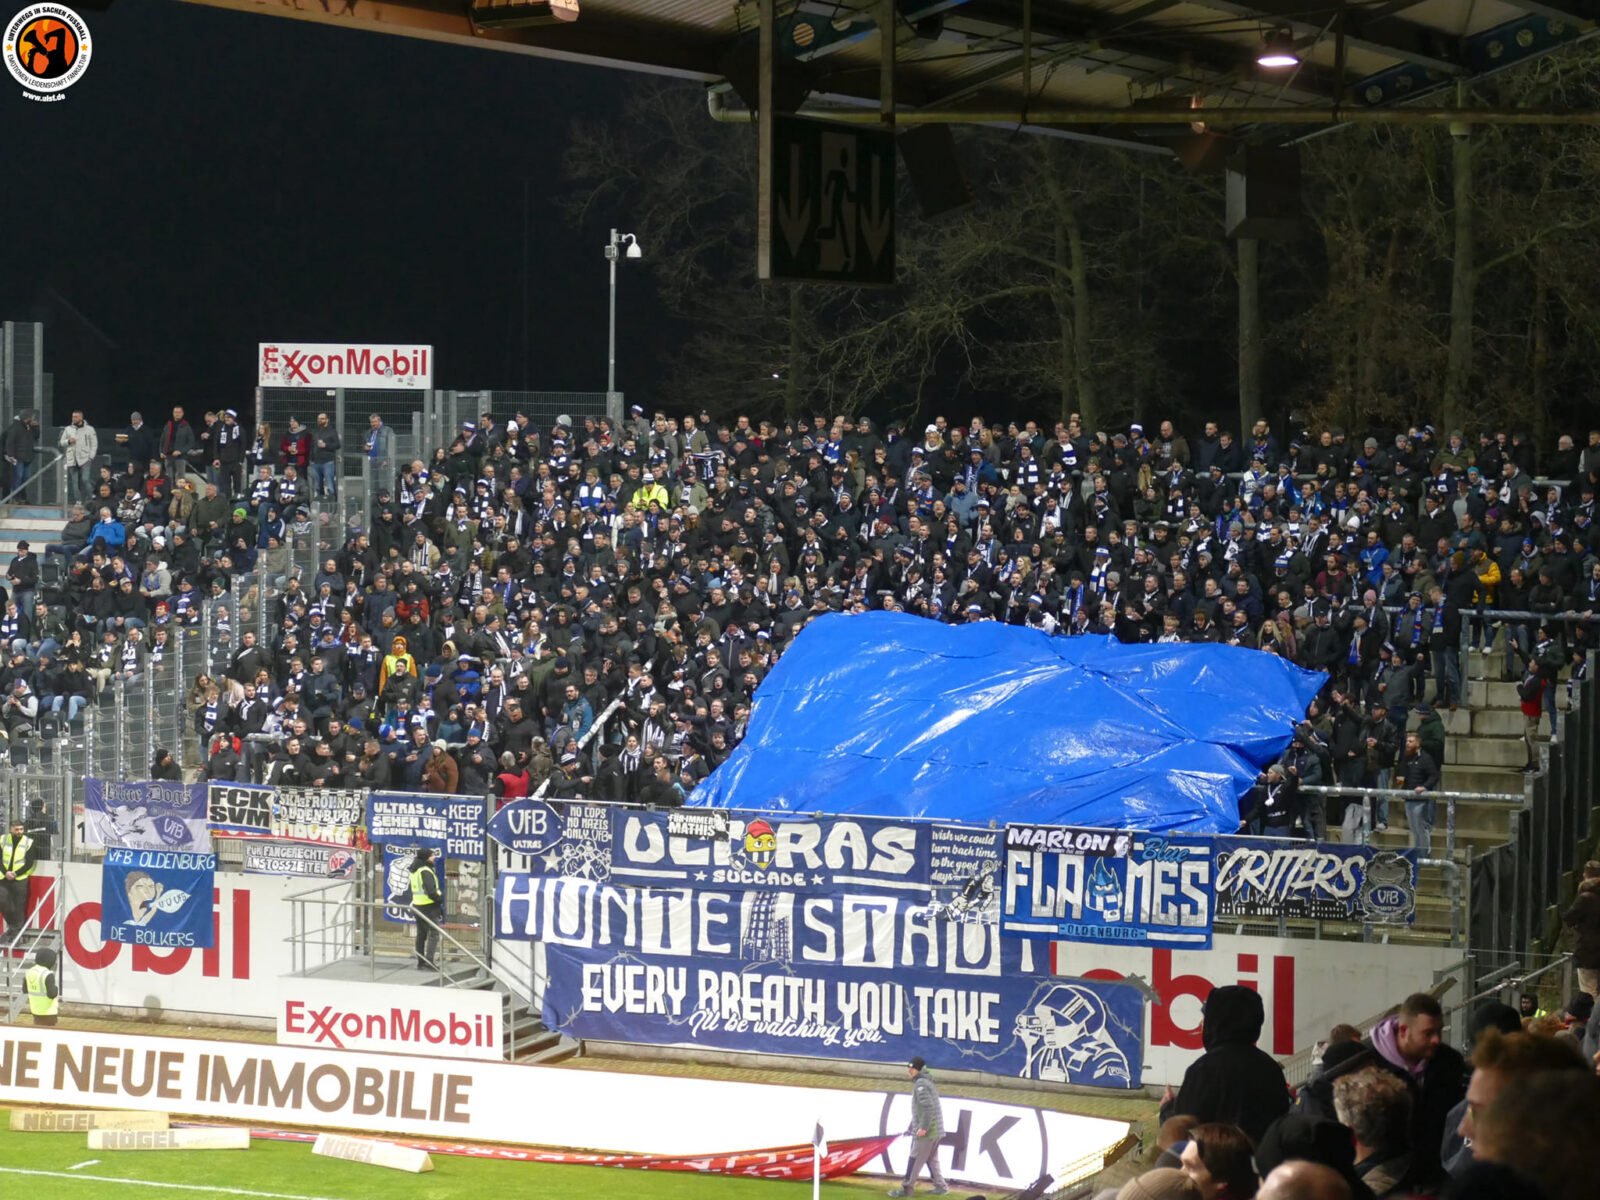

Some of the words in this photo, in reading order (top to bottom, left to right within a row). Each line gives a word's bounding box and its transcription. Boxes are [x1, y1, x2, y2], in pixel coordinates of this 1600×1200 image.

[263, 347, 427, 384] ExxonMobil
[146, 784, 193, 807] Dogs
[210, 787, 272, 810] FCK
[210, 805, 270, 828] SVM
[373, 802, 425, 815] ULTRAS
[448, 804, 482, 820] KEEP
[570, 806, 582, 817] NO
[584, 806, 607, 819] COPS
[372, 815, 420, 828] SEHEN
[423, 817, 447, 832] UN
[507, 809, 547, 835] VfB
[567, 816, 579, 828] NO
[581, 817, 608, 830] NAZIS
[668, 812, 684, 823] FÜR
[686, 814, 714, 825] IMMER
[163, 818, 185, 840] VfB
[372, 827, 413, 837] GESEHEN
[453, 821, 479, 837] THE
[566, 828, 589, 840] ONLY
[591, 830, 609, 842] VfB
[668, 821, 715, 837] MATHIS
[932, 829, 953, 842] wish
[954, 833, 968, 843] we
[969, 833, 996, 846] could
[446, 838, 484, 855] FAITH
[513, 840, 542, 849] ULTRAS
[1008, 828, 1111, 851] MARLON
[264, 846, 329, 861] FANGERECHTE
[386, 845, 441, 858] OLDENG
[931, 843, 950, 854] turn
[952, 844, 974, 856] back
[1142, 837, 1191, 863] Blue
[108, 848, 133, 864] VFB
[139, 851, 216, 870] OLDENBURG
[246, 857, 327, 875] ANSTOSSZEITEN
[931, 857, 940, 867] to
[941, 856, 954, 868] the
[956, 860, 979, 873] good
[712, 869, 807, 887] SUCCADE
[1215, 847, 1366, 902] CRITTERS
[1005, 850, 1210, 927] FLAMES
[1377, 890, 1399, 904] VfB
[110, 926, 127, 942] DE
[582, 963, 687, 1016] EVERY
[698, 968, 825, 1026] BREATH
[837, 981, 904, 1036] YOU
[913, 986, 1001, 1044] TAKE
[285, 1000, 494, 1049] ExxonMobil
[724, 1012, 749, 1033] be
[753, 1016, 841, 1046] watching
[53, 1042, 184, 1101] NEUE
[195, 1053, 474, 1125] IMMOBILIE
[23, 1111, 99, 1131] NÖGEL
[102, 1129, 180, 1149] NÖGEL
